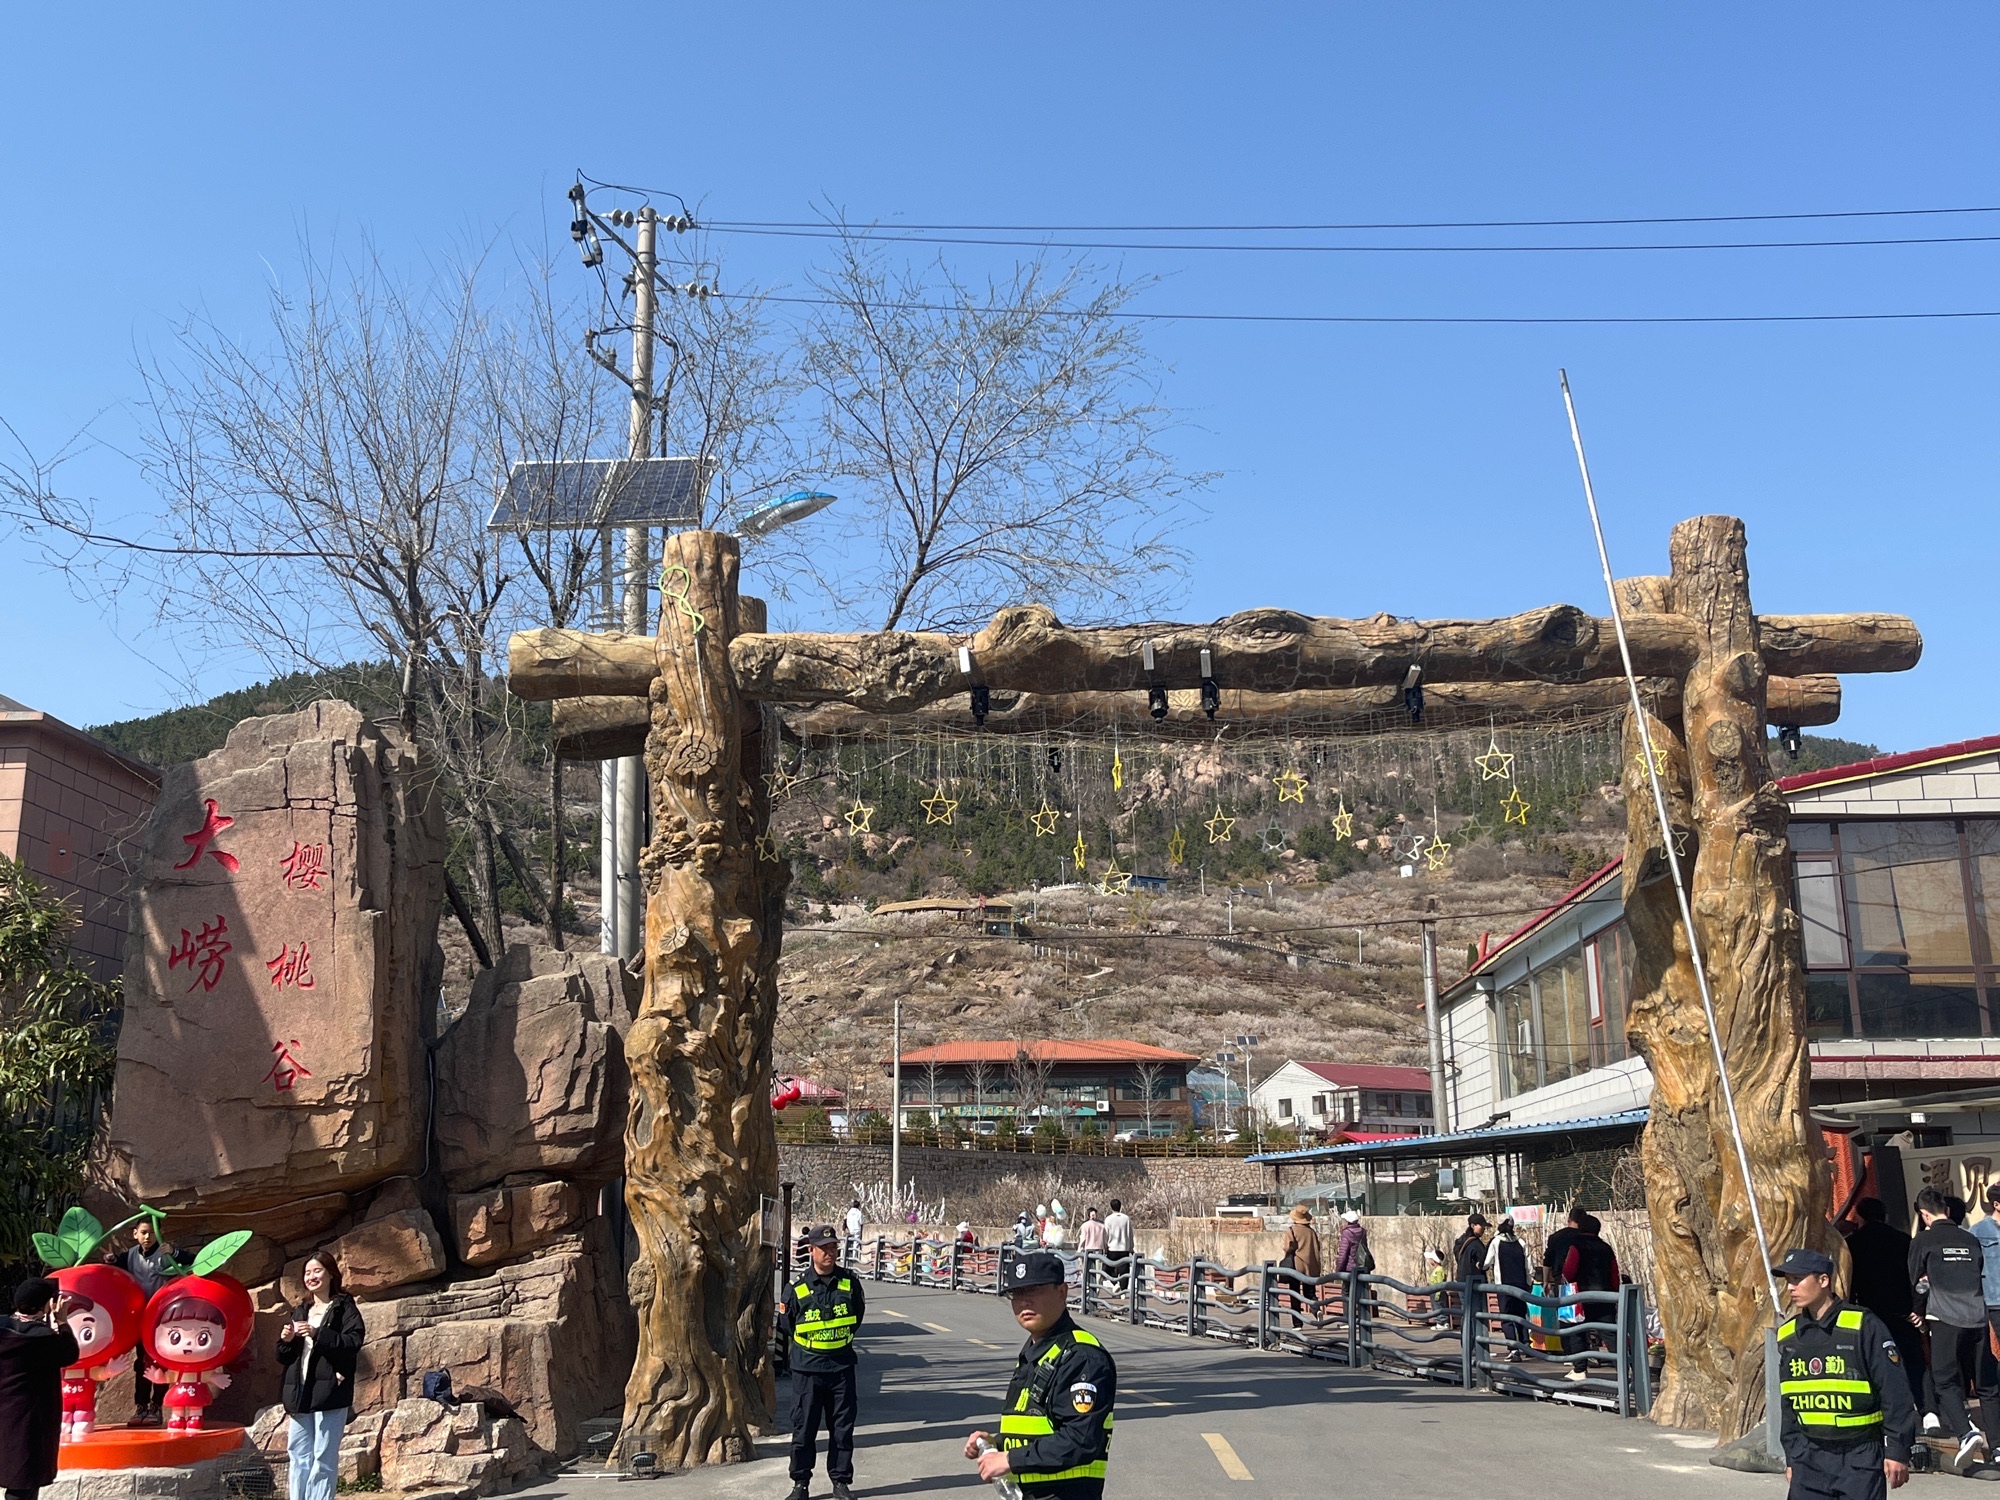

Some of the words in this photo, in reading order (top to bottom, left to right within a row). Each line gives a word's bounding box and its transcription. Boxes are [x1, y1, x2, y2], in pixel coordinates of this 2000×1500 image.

[168, 797, 240, 993] 大崂
[262, 841, 329, 1092] 樱桃谷
[1789, 1356, 1845, 1377] 执勤
[1789, 1395, 1852, 1410] ZHIQIN
